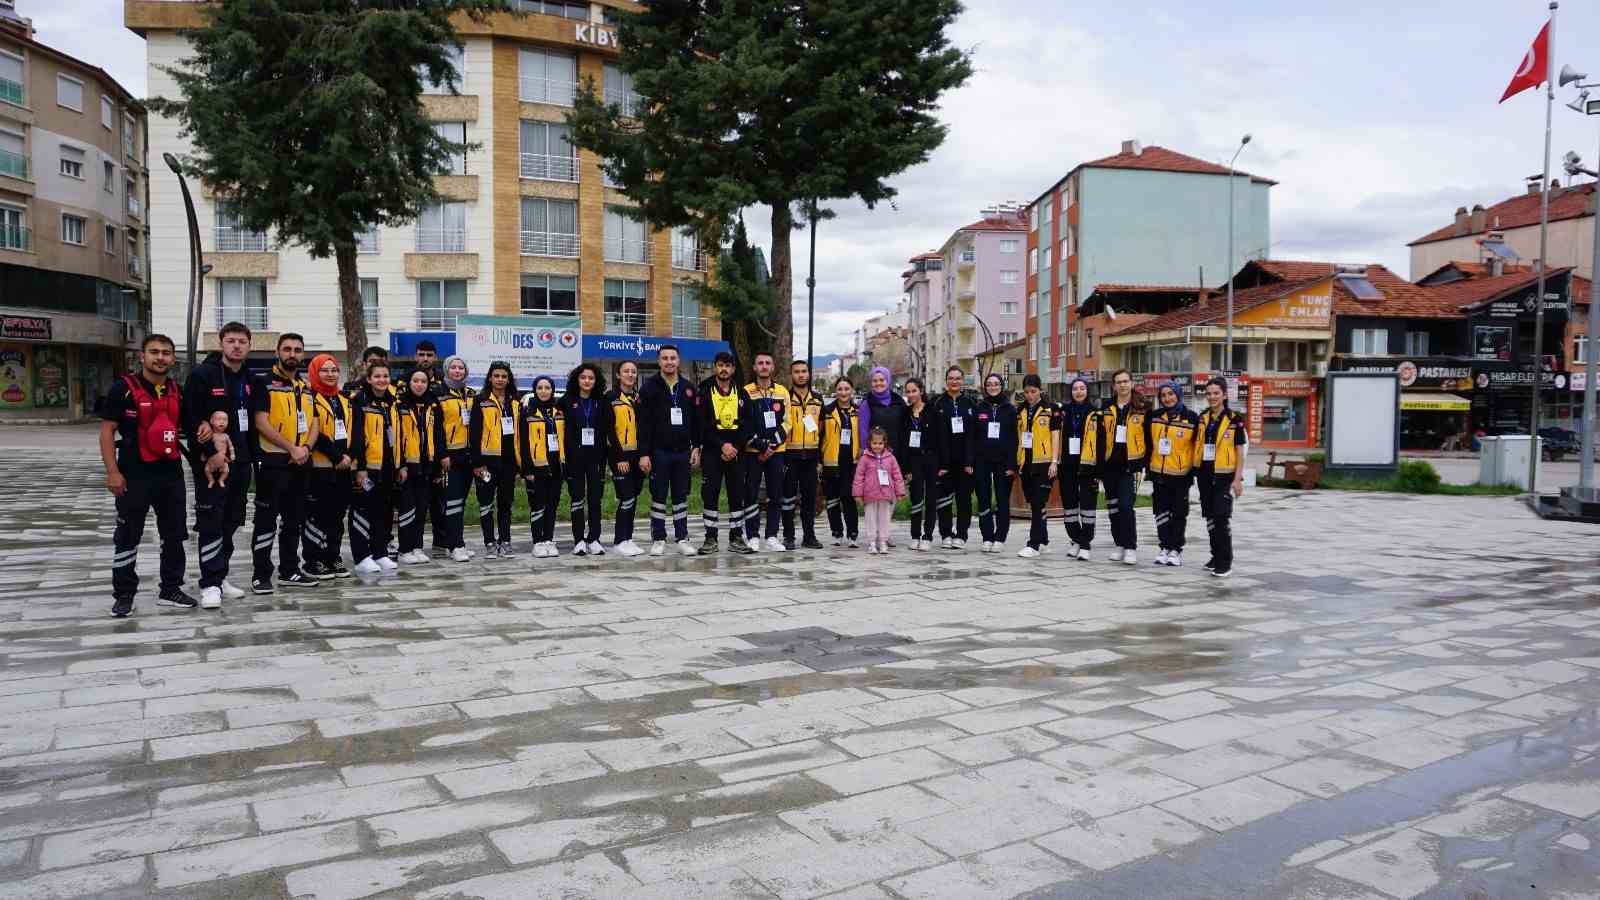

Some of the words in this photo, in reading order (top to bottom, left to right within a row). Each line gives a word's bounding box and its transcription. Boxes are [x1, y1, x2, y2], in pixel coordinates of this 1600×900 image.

[512, 333, 534, 349] DES
[598, 340, 635, 351] TÜRKİYE
[644, 343, 664, 351] BAN
